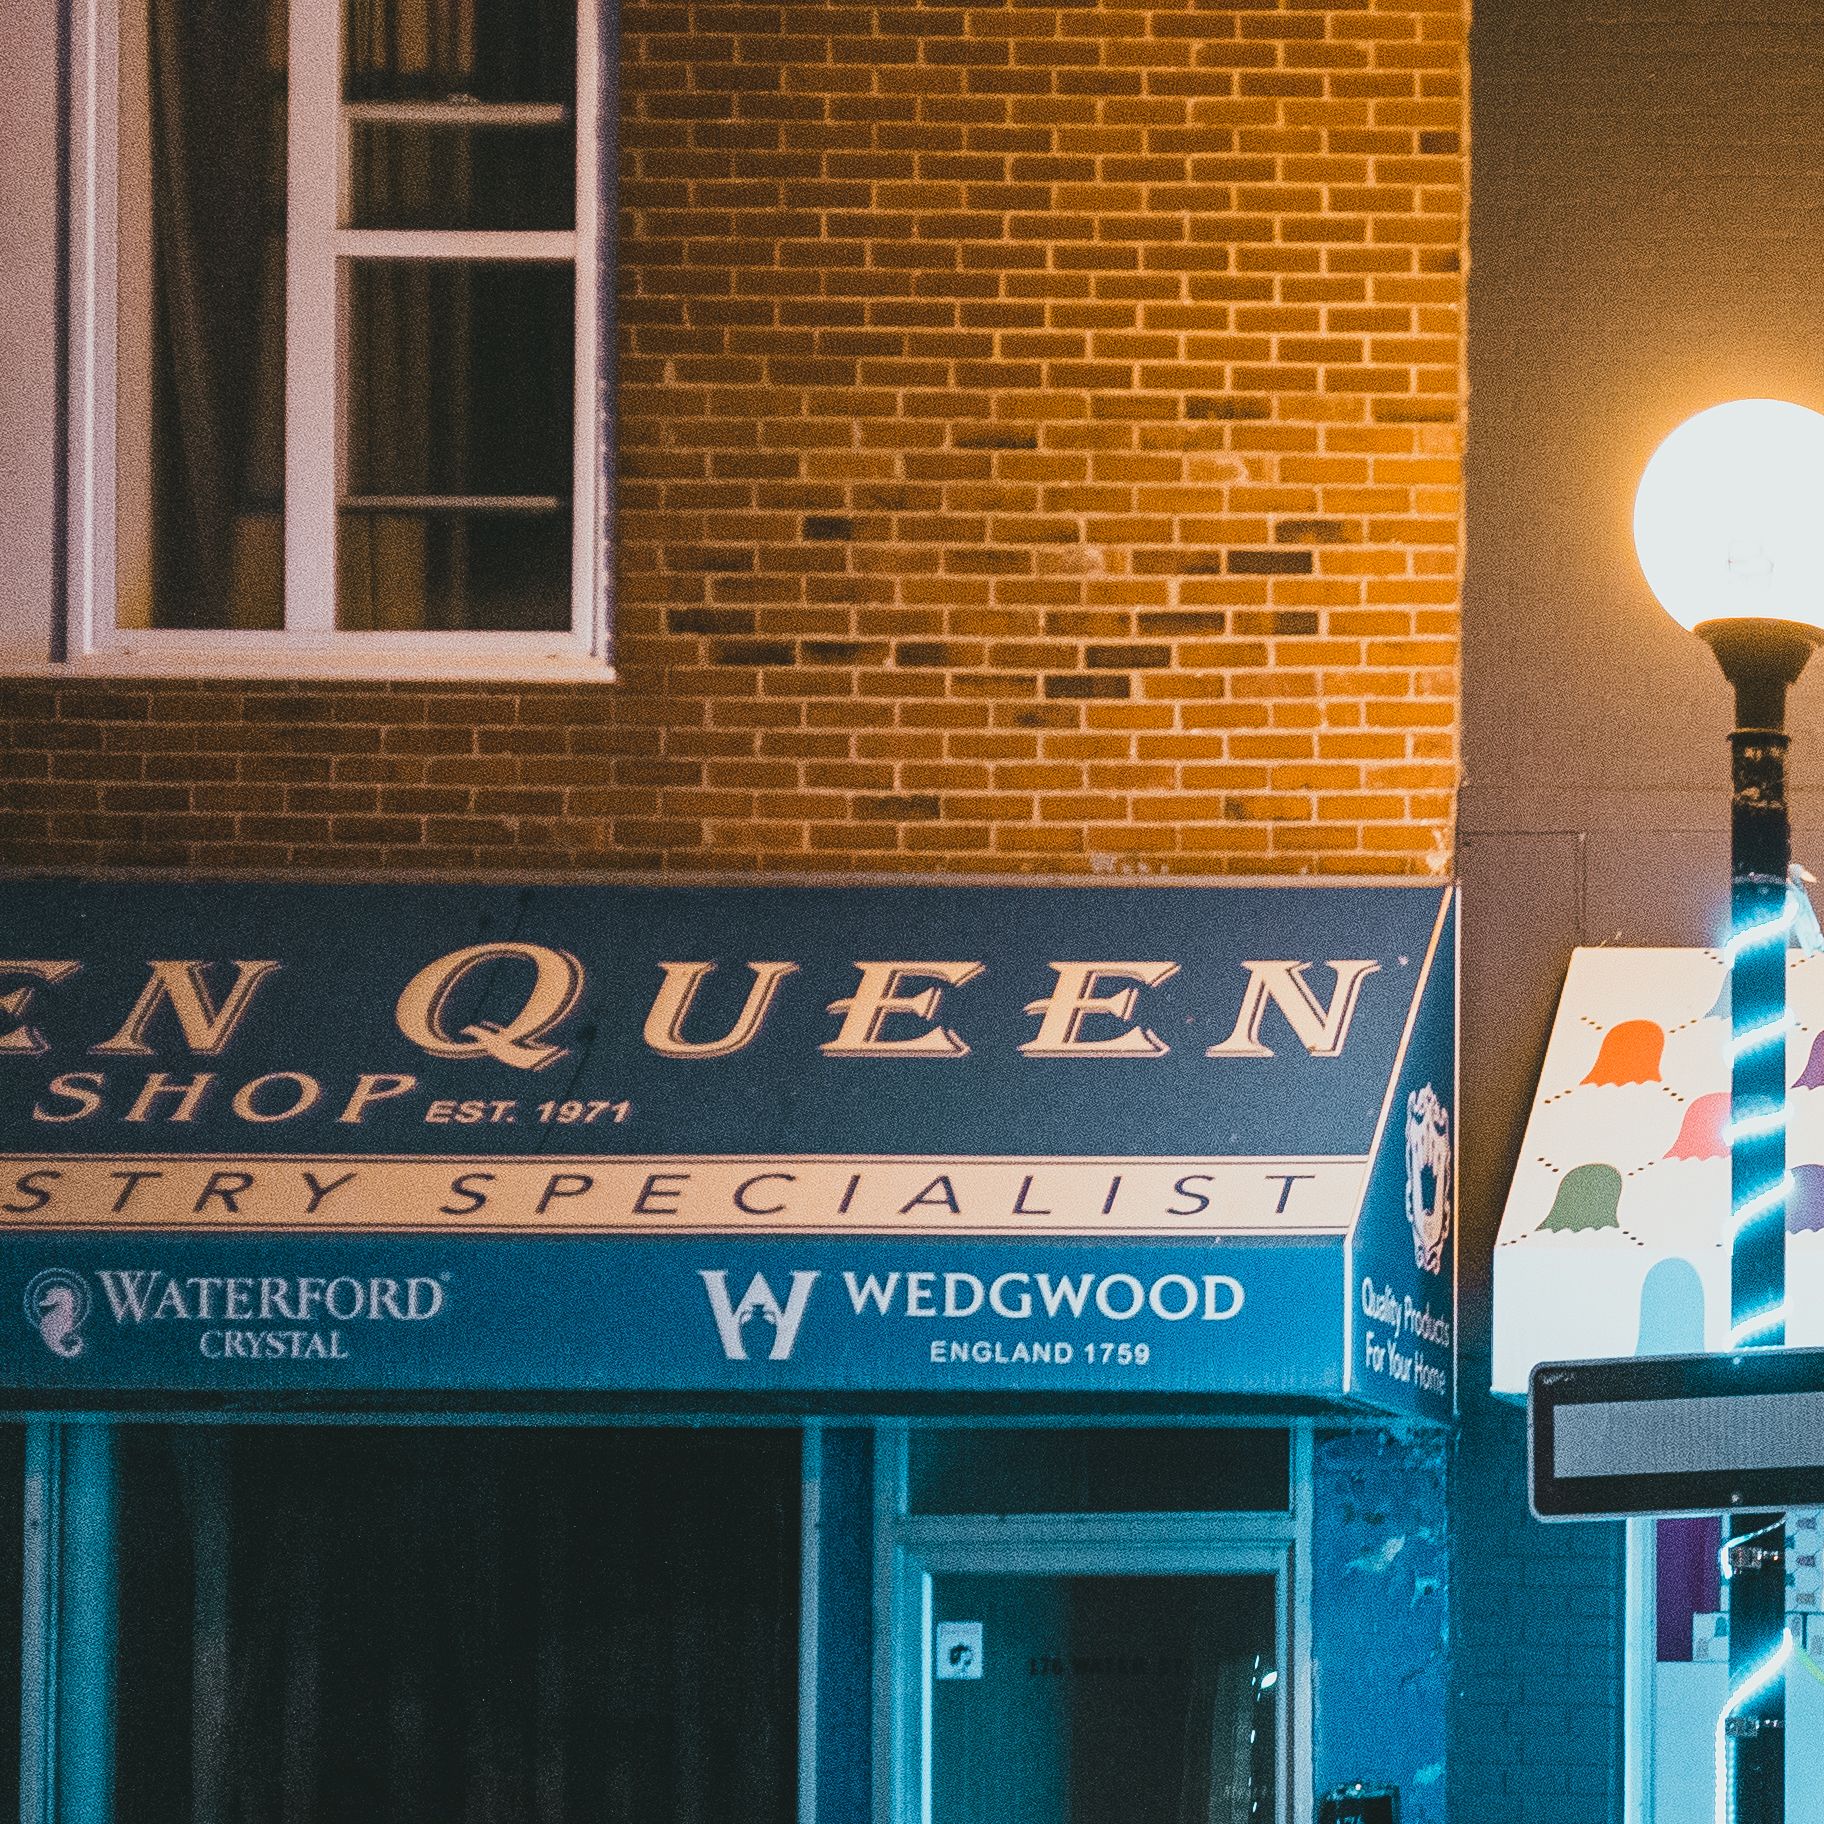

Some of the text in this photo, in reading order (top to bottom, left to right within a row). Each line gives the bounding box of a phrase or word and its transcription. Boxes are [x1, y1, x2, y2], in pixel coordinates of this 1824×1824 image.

[394, 941, 1382, 1071] QUEEN
[32, 1071, 632, 1125] SHOP EST. 1971
[1, 1170, 1316, 1217] STRY SPECIALIST
[843, 1273, 1246, 1322] WEDGWOOD
[1361, 1276, 1450, 1348] Quality Products
[199, 1330, 350, 1360] CRYSTAL
[929, 1340, 1152, 1367] ENGLAND 1759
